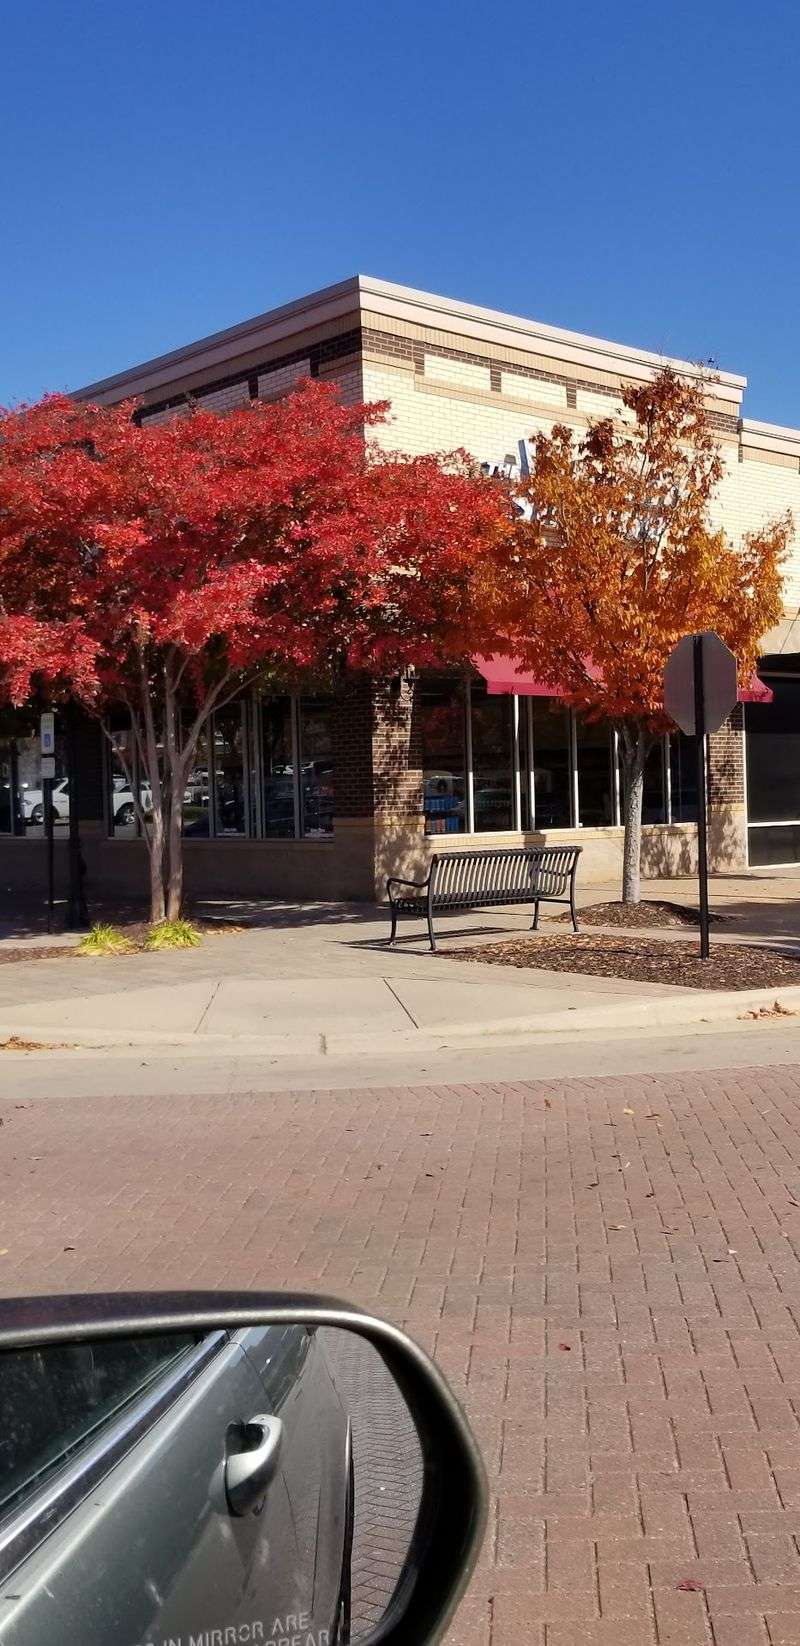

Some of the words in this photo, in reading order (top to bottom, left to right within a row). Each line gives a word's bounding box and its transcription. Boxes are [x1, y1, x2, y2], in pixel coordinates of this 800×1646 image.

[189, 1621, 264, 1646] MIRROR
[272, 1612, 309, 1635] ARE
[256, 1629, 329, 1646] EAR
